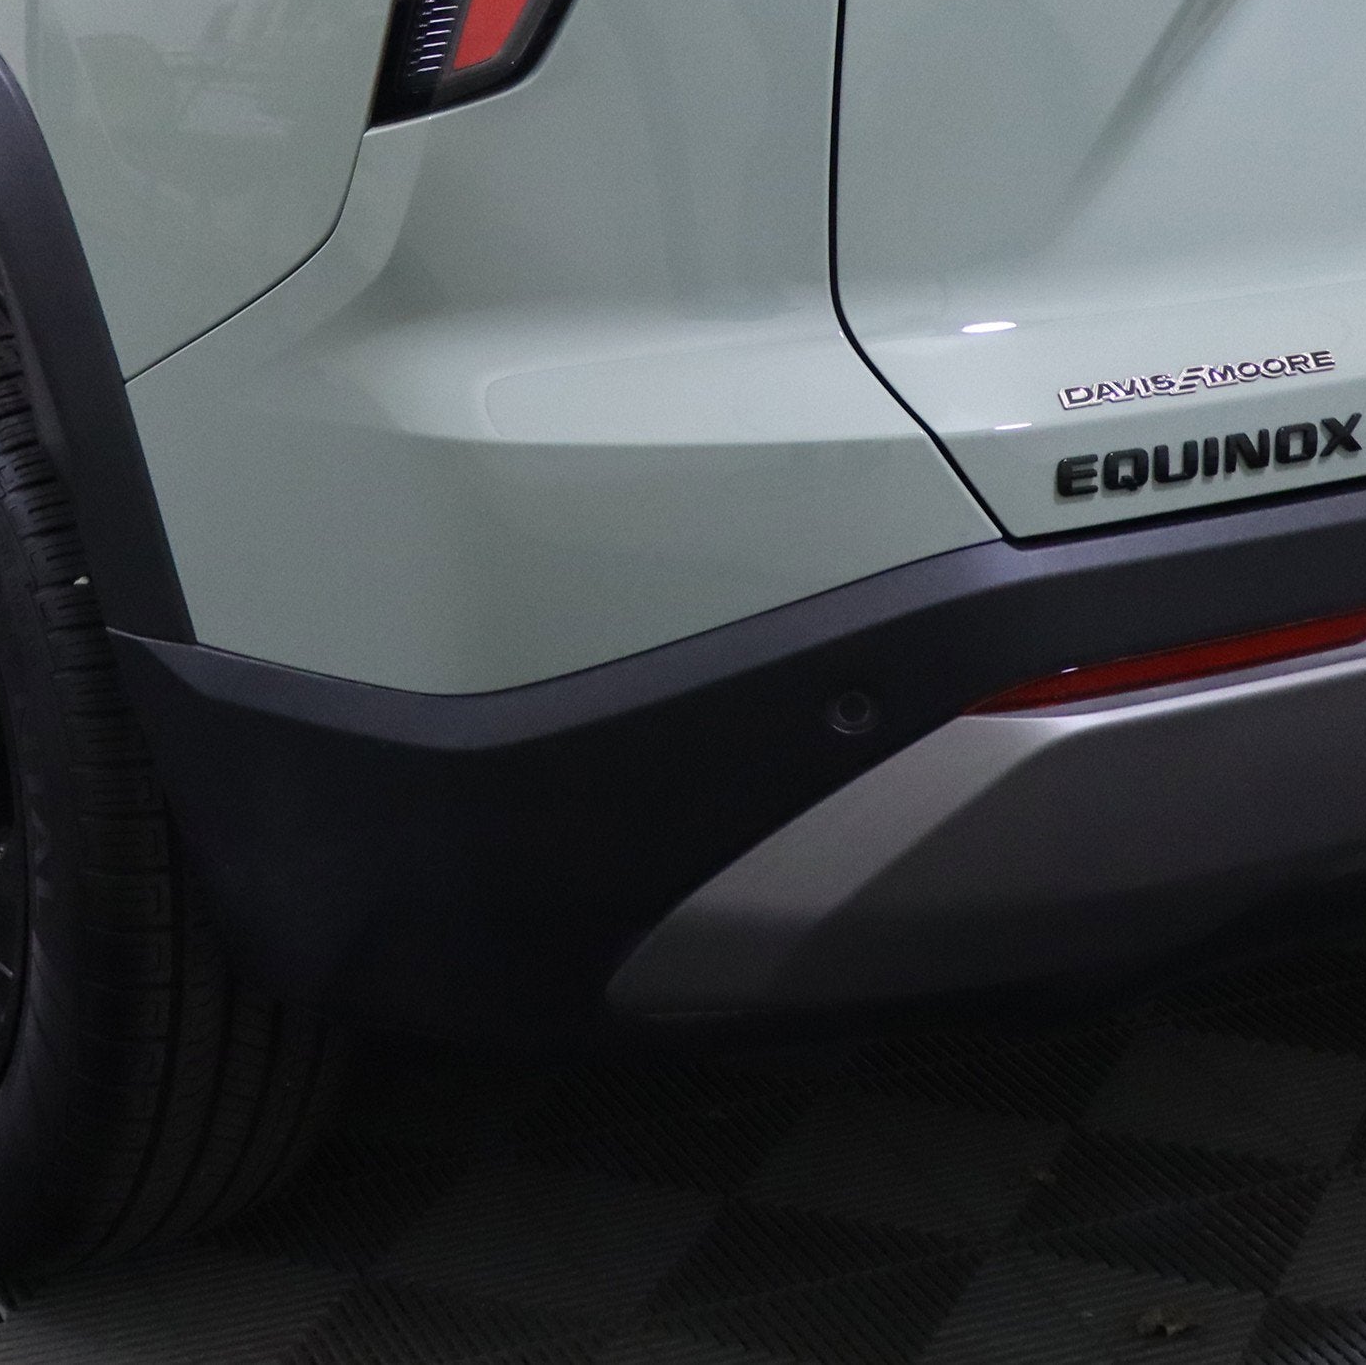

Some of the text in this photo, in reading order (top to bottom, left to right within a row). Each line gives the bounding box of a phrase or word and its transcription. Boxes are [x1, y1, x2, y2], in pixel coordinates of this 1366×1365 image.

[1058, 349, 1336, 410] DAVIS MOORE
[1056, 412, 1363, 498] EQUINOX
